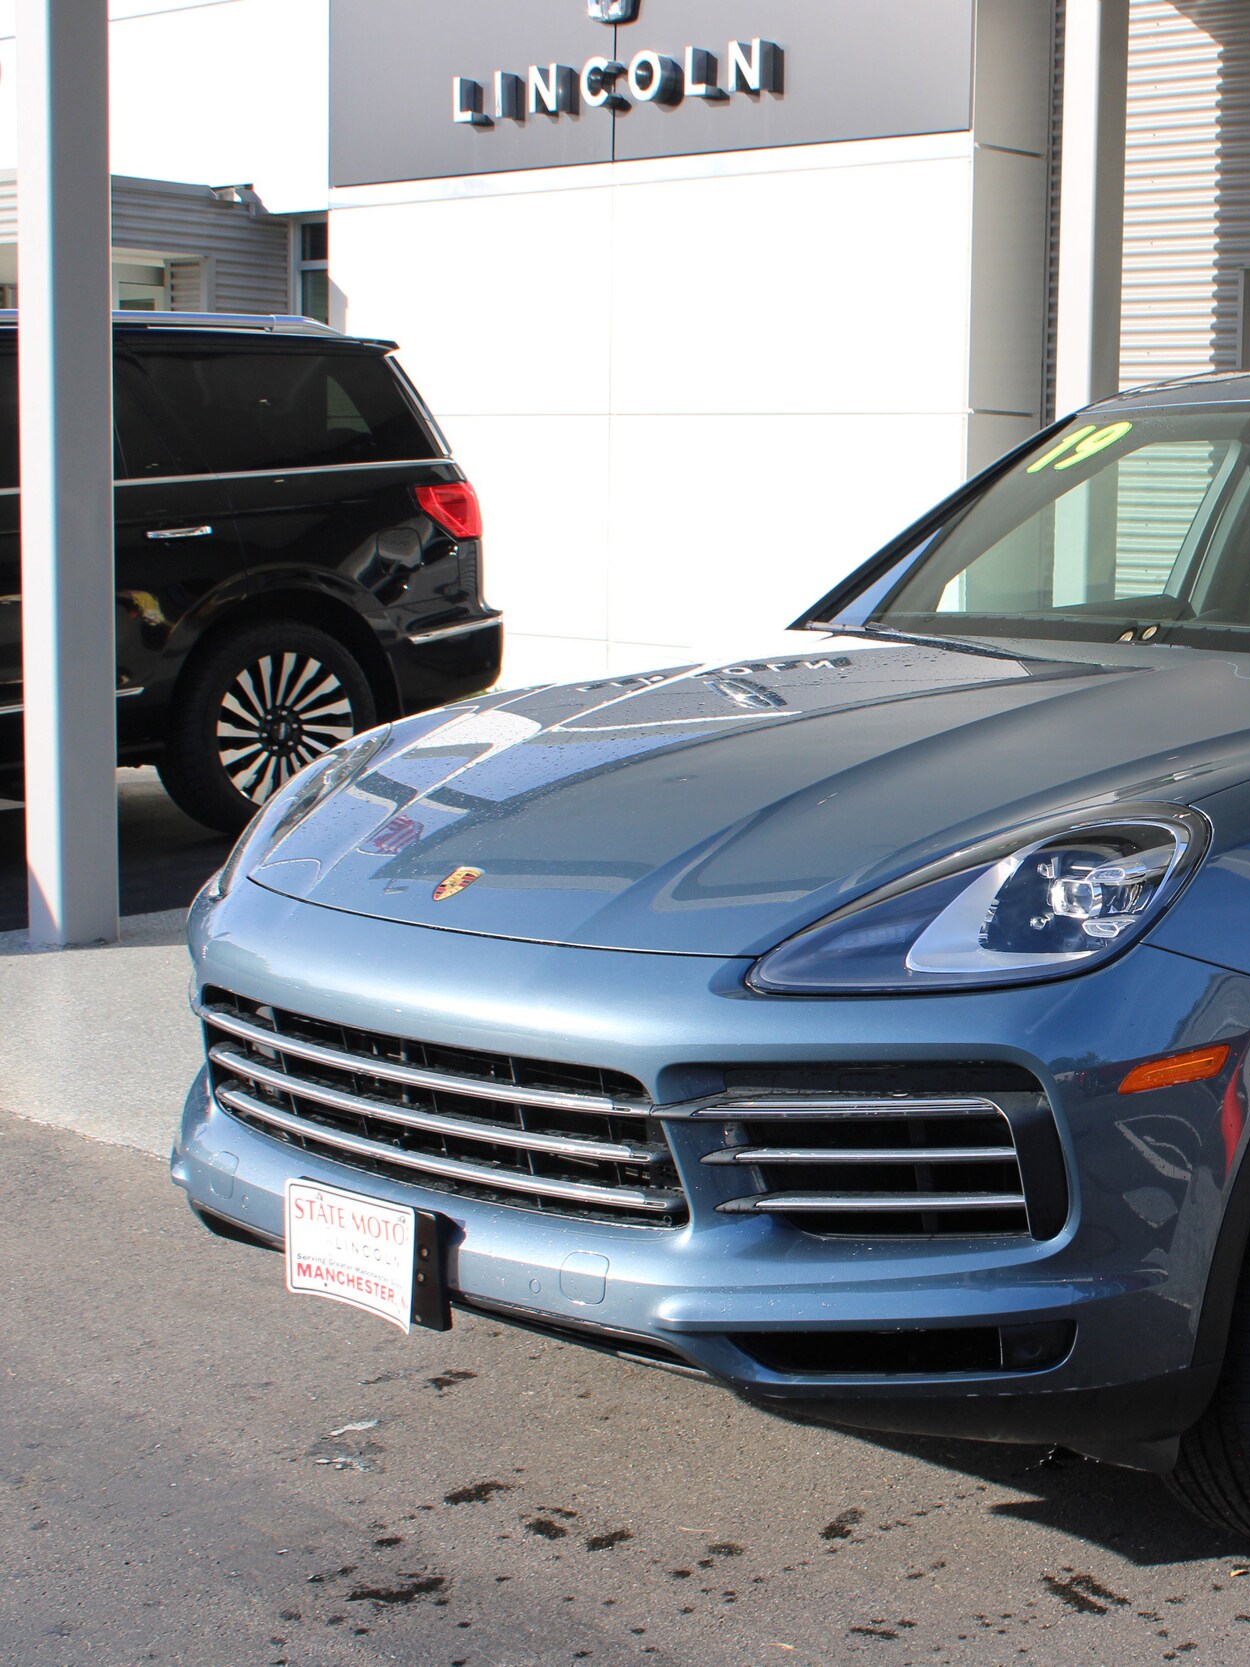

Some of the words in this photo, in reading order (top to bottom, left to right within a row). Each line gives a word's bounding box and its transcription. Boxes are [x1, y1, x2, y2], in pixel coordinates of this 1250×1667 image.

[452, 37, 780, 130] LINCOLN
[1026, 421, 1133, 474] 19
[294, 1197, 346, 1229] STATE
[351, 1211, 408, 1246] MOTO
[296, 1252, 327, 1265] Serving
[328, 1257, 353, 1271] Greater
[335, 1236, 401, 1268] LINCOLN
